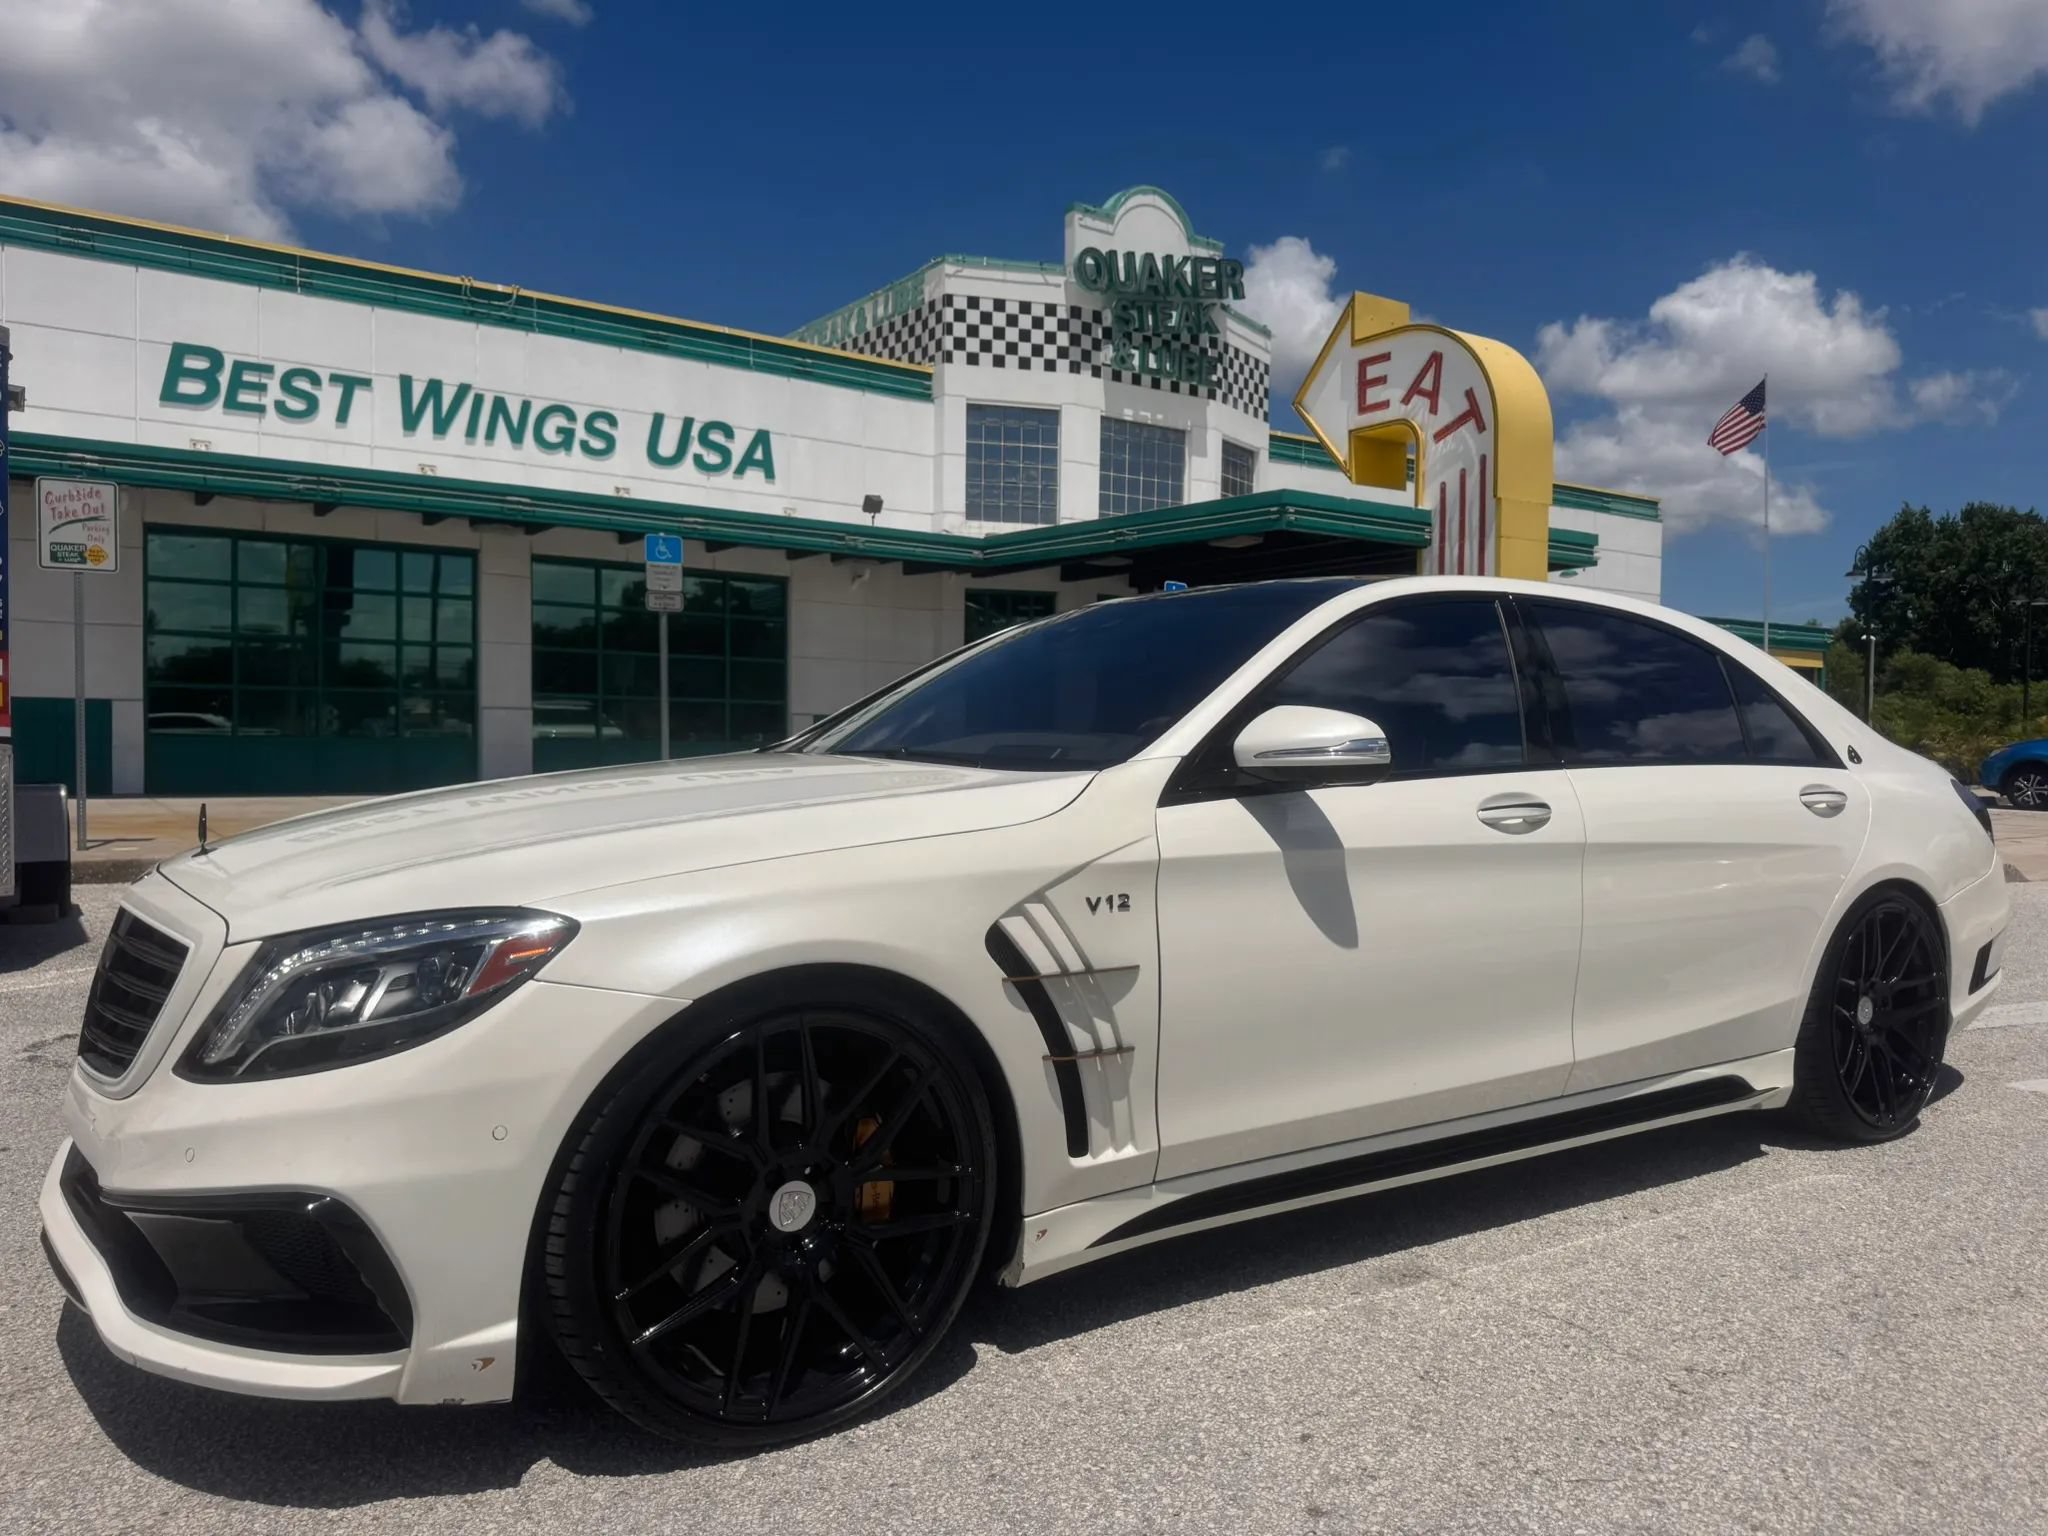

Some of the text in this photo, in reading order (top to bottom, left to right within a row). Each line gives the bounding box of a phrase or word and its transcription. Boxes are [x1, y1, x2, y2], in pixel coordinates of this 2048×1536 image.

[1074, 247, 1246, 300] QUAKER
[1112, 301, 1220, 335] STEAK
[1111, 337, 1219, 387] & LUBE
[159, 341, 776, 481] BEST WINGS USA
[1357, 350, 1487, 444] EAT
[51, 502, 104, 521] Take Out
[50, 544, 86, 552] QUAKER
[1085, 893, 1131, 916] V12
